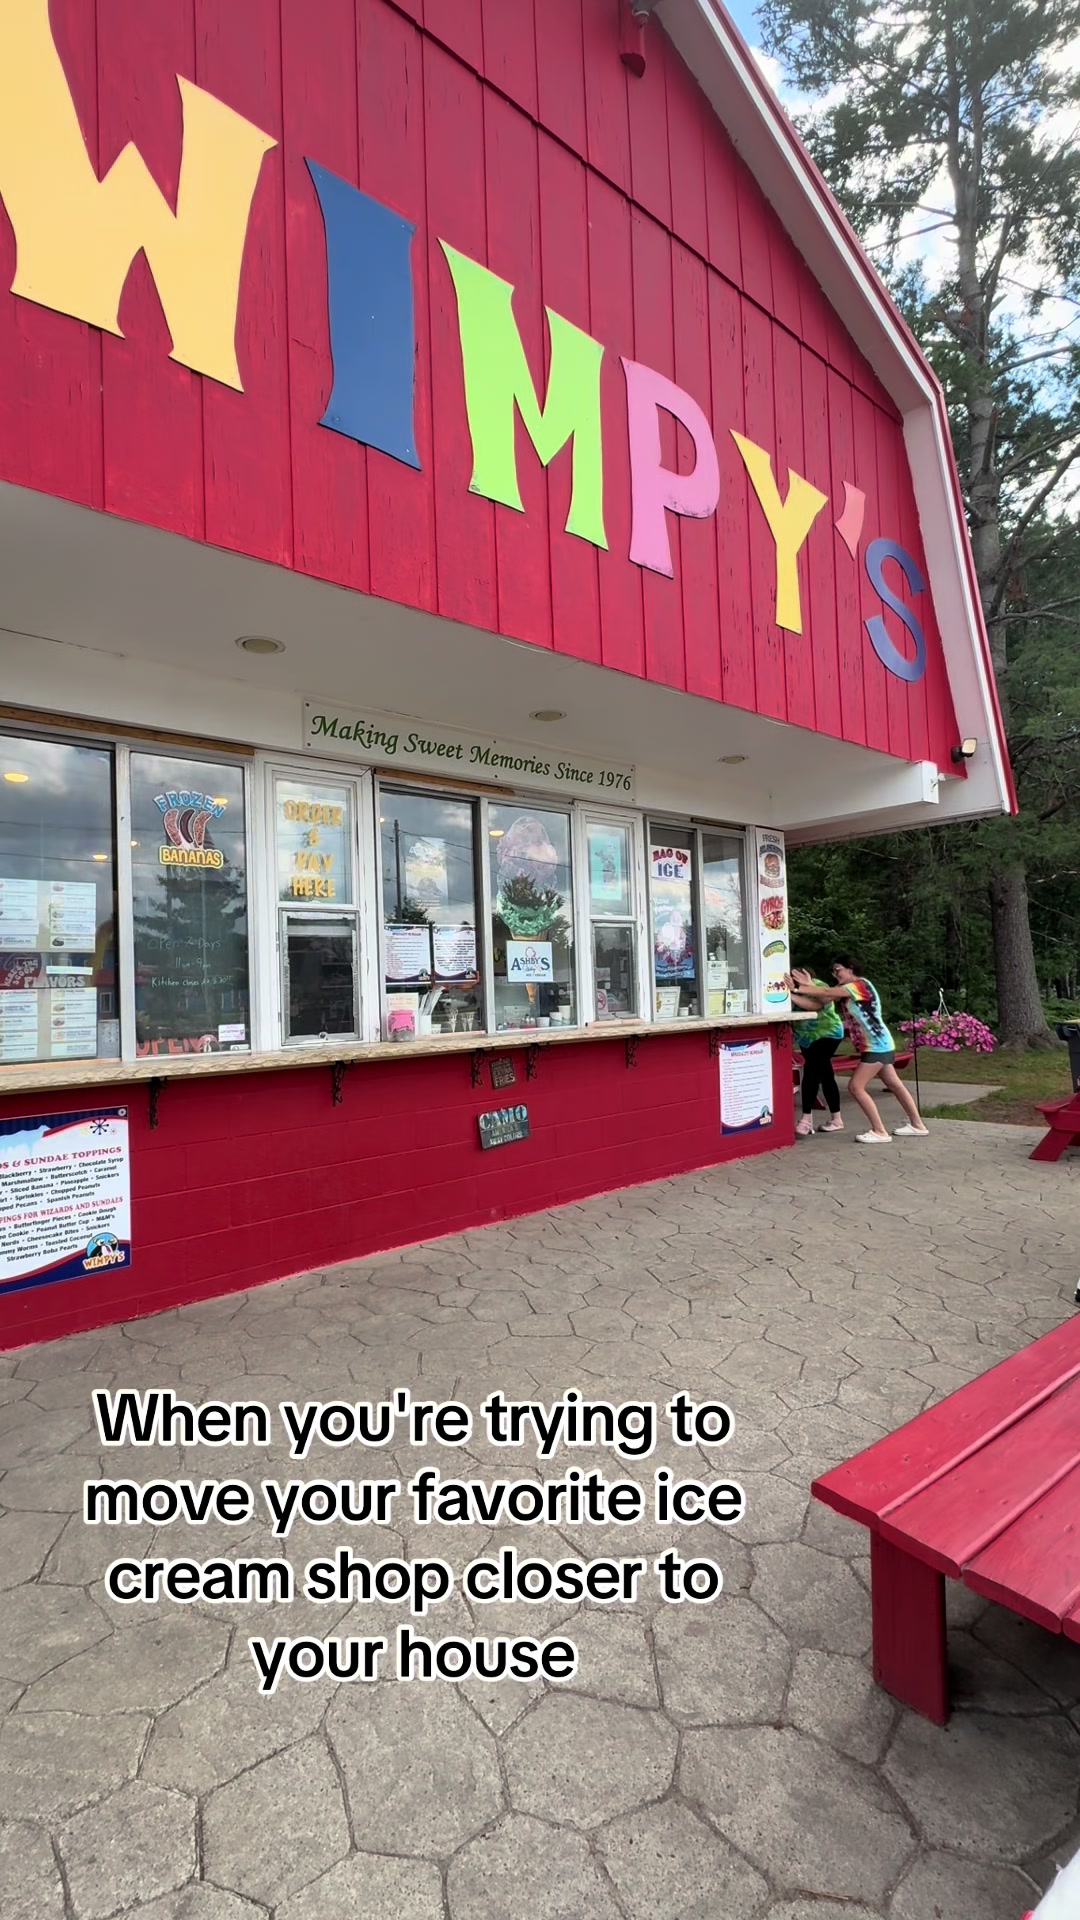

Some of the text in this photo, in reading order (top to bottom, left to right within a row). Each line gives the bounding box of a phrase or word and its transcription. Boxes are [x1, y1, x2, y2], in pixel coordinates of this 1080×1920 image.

[0, 0, 926, 682] WIMPY'S
[311, 715, 632, 791] Making Sweet Memories Since 1976
[153, 790, 226, 818] FROZEN
[284, 800, 342, 826] ORDER
[161, 847, 221, 867] BANANAS
[296, 850, 334, 873] PAY
[658, 862, 683, 878] ICE
[292, 877, 335, 897] HERE
[510, 956, 551, 971] ASHBY'S
[24, 976, 85, 988] FLAVORS
[480, 1105, 527, 1130] CAMO
[12, 1160, 21, 1168] &
[24, 1153, 69, 1167] SUNDAE
[72, 1146, 122, 1159] TOPPINGS
[39, 1165, 72, 1174] Strawberry
[78, 1159, 106, 1168] Chocolate
[1, 1177, 44, 1187] Marshmallow
[50, 1169, 88, 1179] Butterscotch
[60, 1177, 89, 1185] Pineapple
[95, 1172, 119, 1180] Snickers
[15, 1192, 44, 1201] Sprinkles
[50, 1186, 76, 1195] Chopped
[77, 1182, 101, 1190] Peanuts
[46, 1194, 70, 1203] Spanish
[23, 1211, 38, 1219] FOR
[40, 1205, 73, 1216] WIZARDS
[75, 1202, 90, 1210] AND
[91, 1196, 123, 1207] SUNDAES
[8, 1230, 29, 1238] Cookie
[36, 1224, 57, 1232] Peanut
[59, 1221, 77, 1229] Butter
[13, 1219, 50, 1229] Butterfinger
[52, 1214, 71, 1222] Pieces
[27, 1232, 63, 1242] Cheesecake
[86, 1223, 110, 1231] Snickers
[17, 1244, 38, 1252] Worms
[45, 1238, 68, 1246] Toasted
[70, 1233, 93, 1241] Coconut
[6, 1251, 41, 1262] Strawberry
[83, 1252, 124, 1268] WIMPY'S
